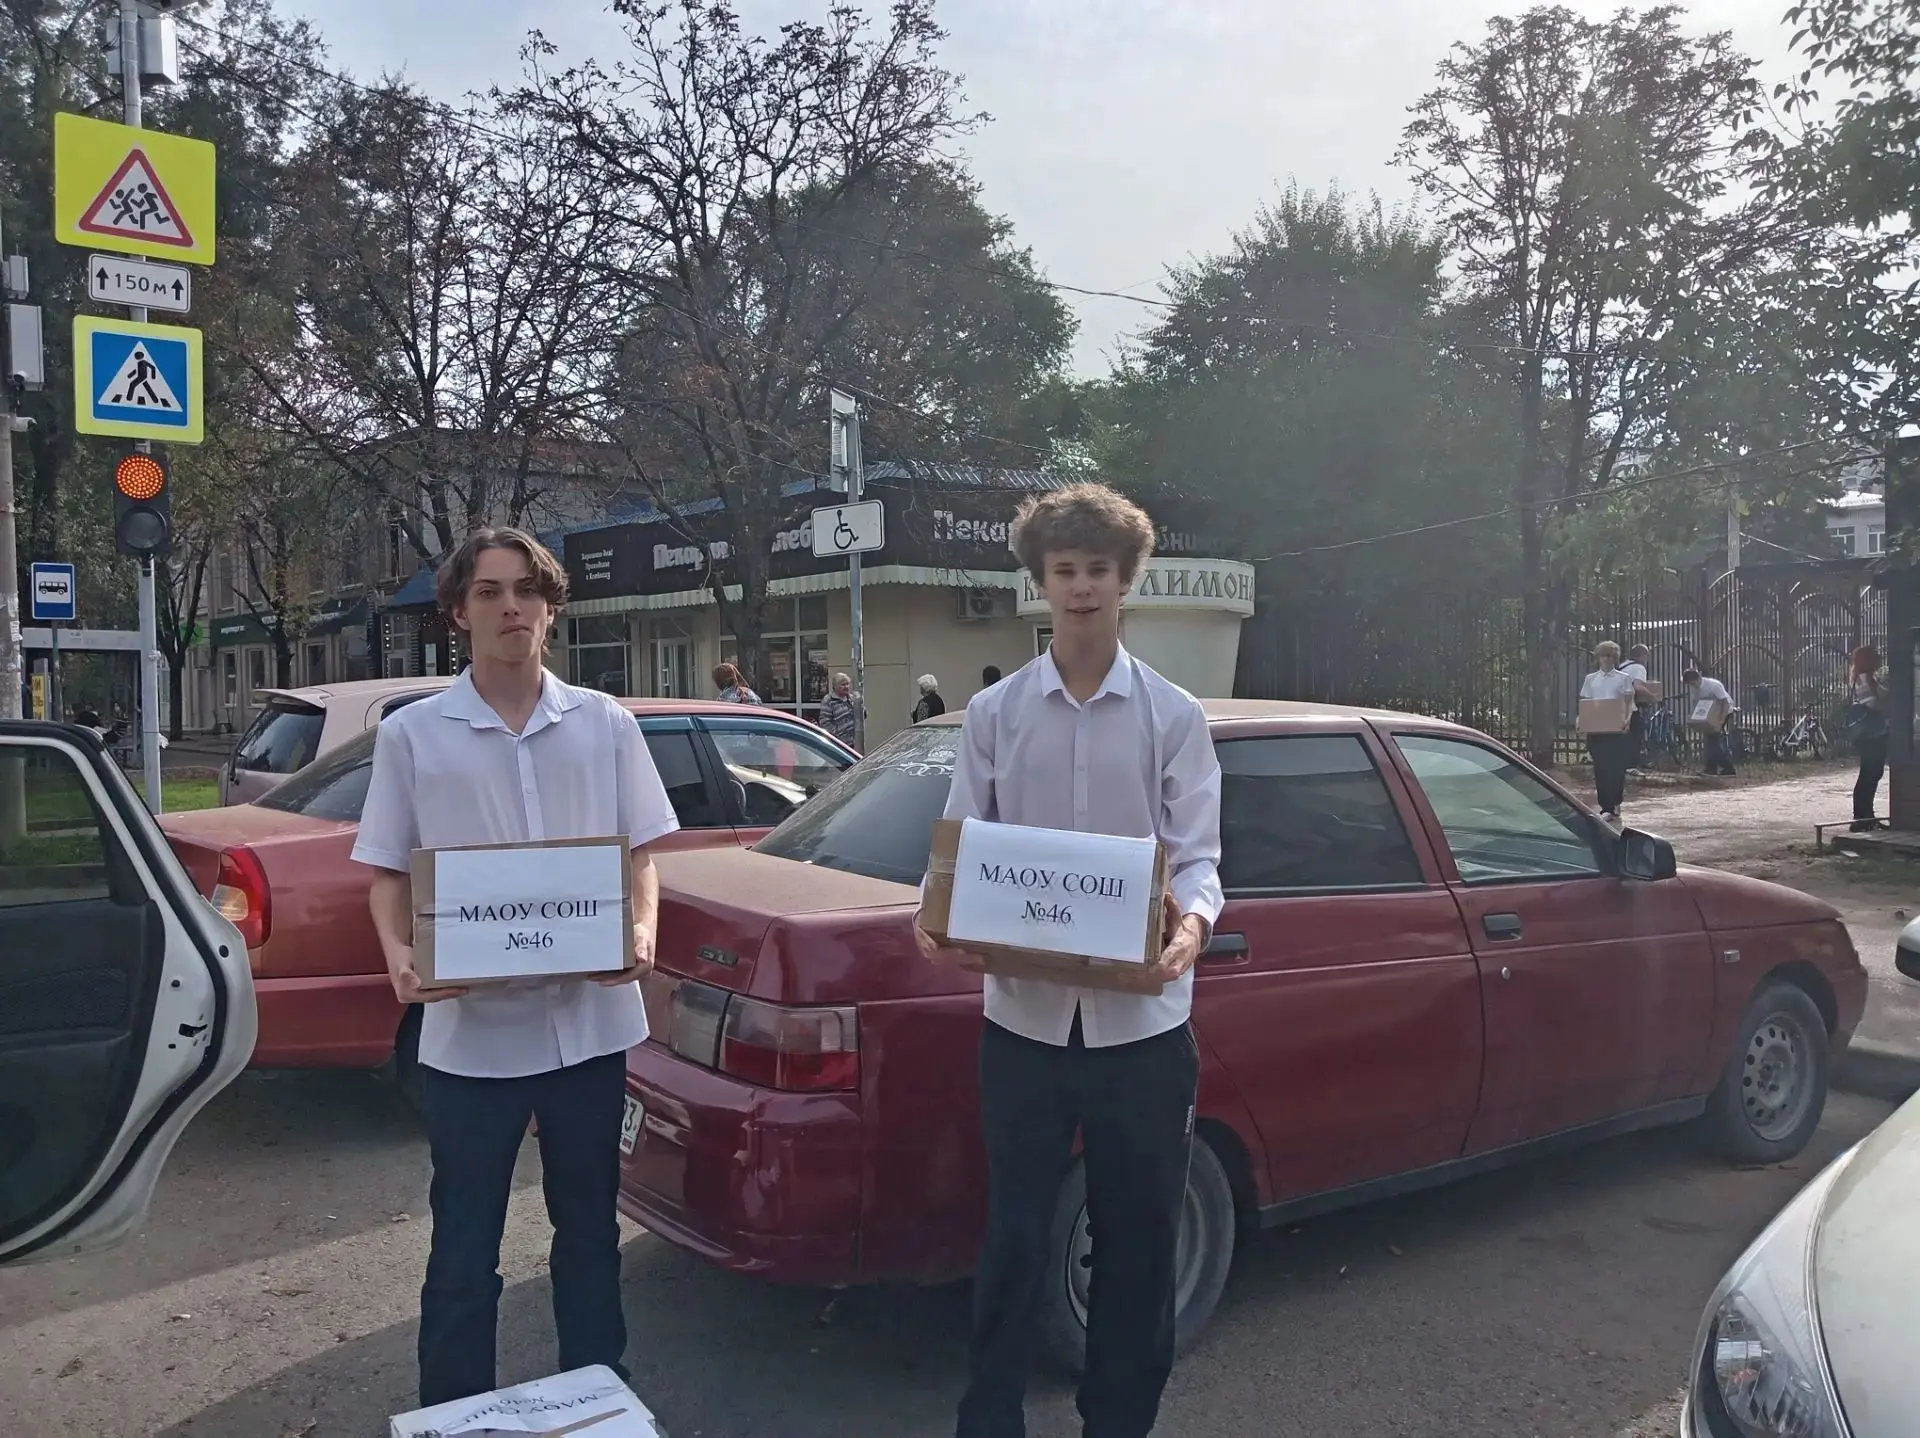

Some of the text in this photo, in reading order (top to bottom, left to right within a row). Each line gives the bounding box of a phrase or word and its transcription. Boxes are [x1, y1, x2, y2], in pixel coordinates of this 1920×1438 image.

[979, 863, 1125, 898] МАОУ СОШ
[459, 899, 598, 923] МАОУ СОШ
[1021, 900, 1073, 924] №46
[505, 931, 554, 951] №46
